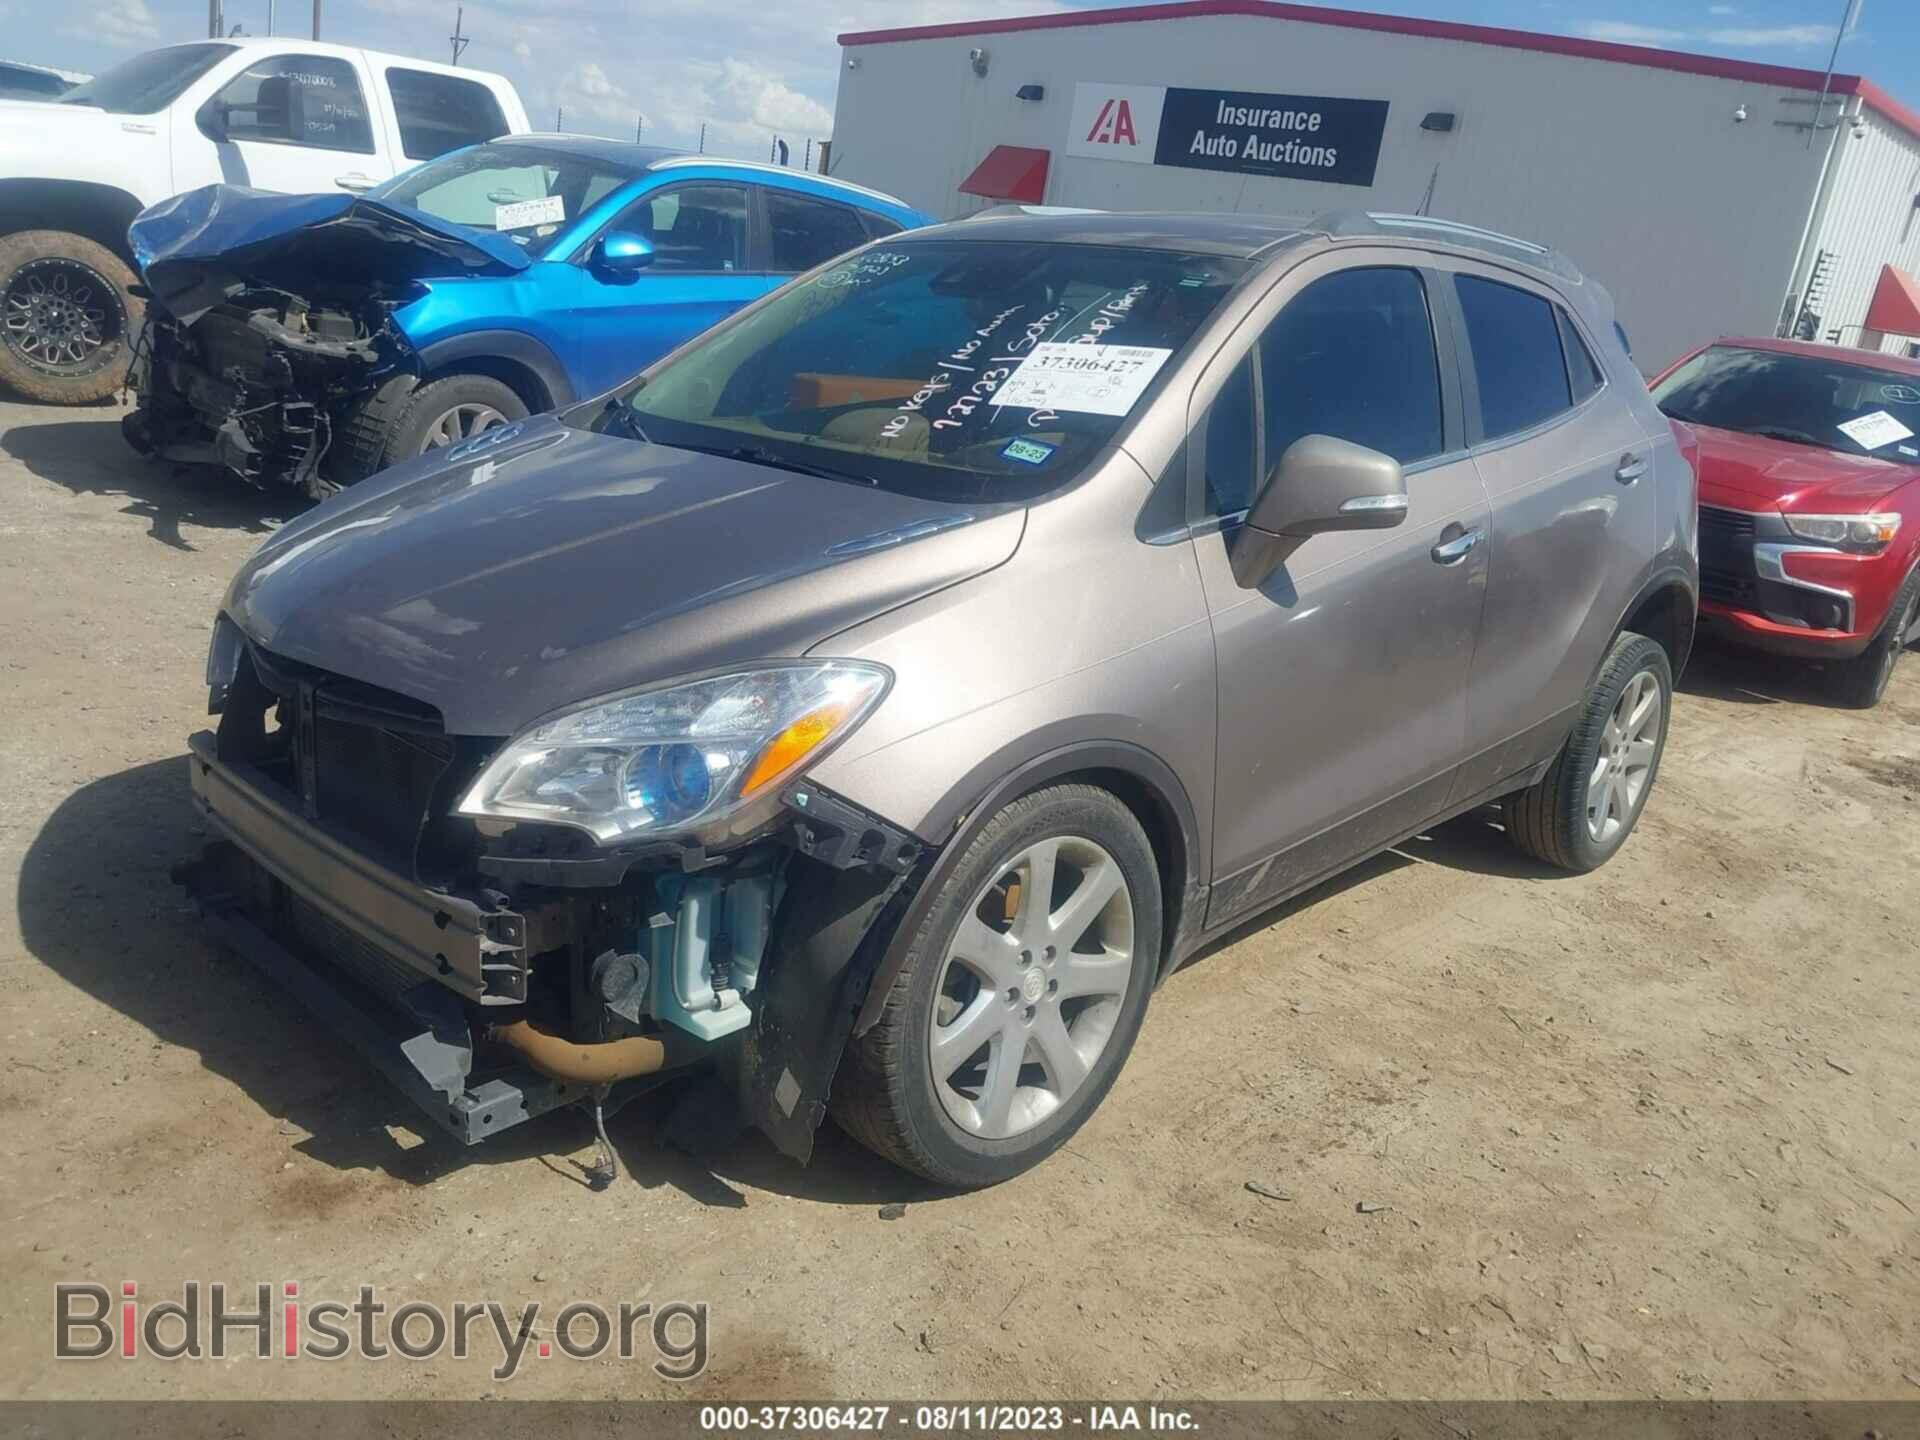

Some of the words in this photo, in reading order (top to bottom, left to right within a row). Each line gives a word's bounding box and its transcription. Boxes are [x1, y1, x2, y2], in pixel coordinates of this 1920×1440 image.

[1216, 100, 1321, 132] Insurance
[1190, 130, 1237, 158] Auto
[1242, 133, 1336, 168] Auctions
[1033, 356, 1144, 375] 37306427
